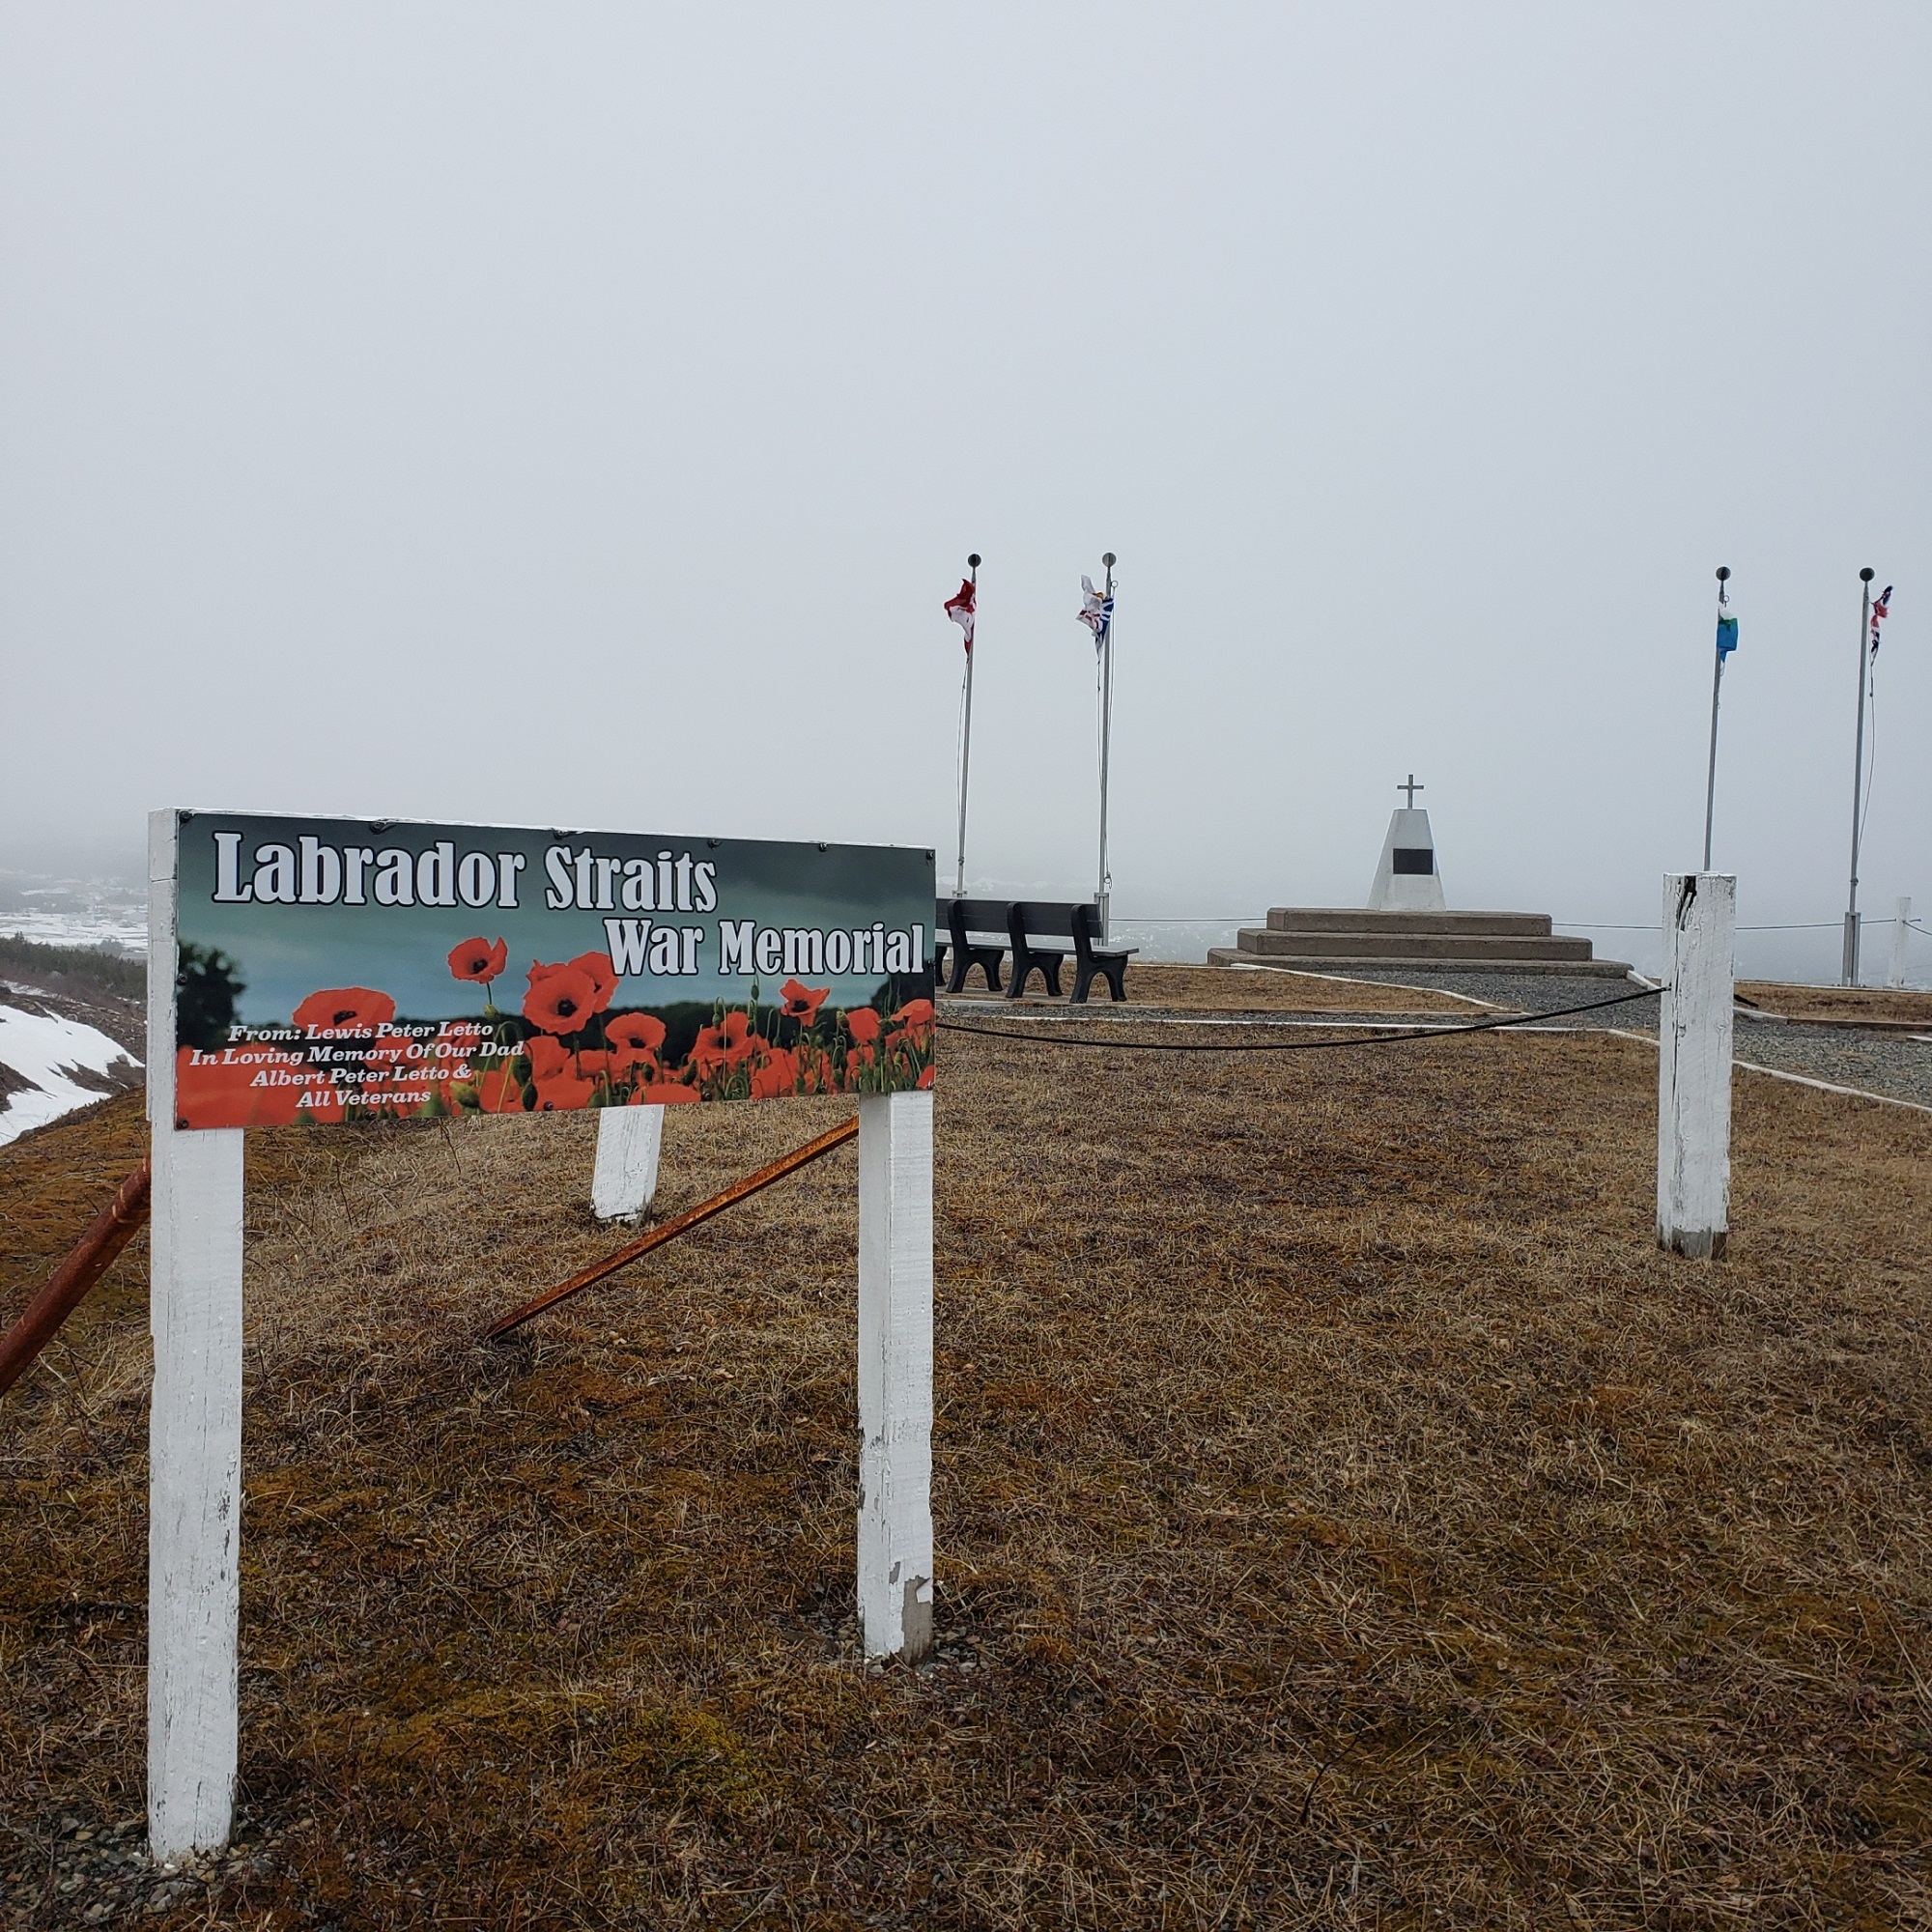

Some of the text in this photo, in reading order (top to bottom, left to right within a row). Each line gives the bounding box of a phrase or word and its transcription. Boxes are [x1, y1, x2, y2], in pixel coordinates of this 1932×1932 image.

[213, 831, 718, 912] Labrador Straits
[604, 918, 924, 976] War Memorial
[228, 1021, 493, 1042] From: Lewis Peter Letto
[190, 1040, 525, 1066] In Loving Memory Of Our Dad
[250, 1064, 472, 1087] Albert Peter Letto &
[296, 1089, 432, 1108] All Veterans
